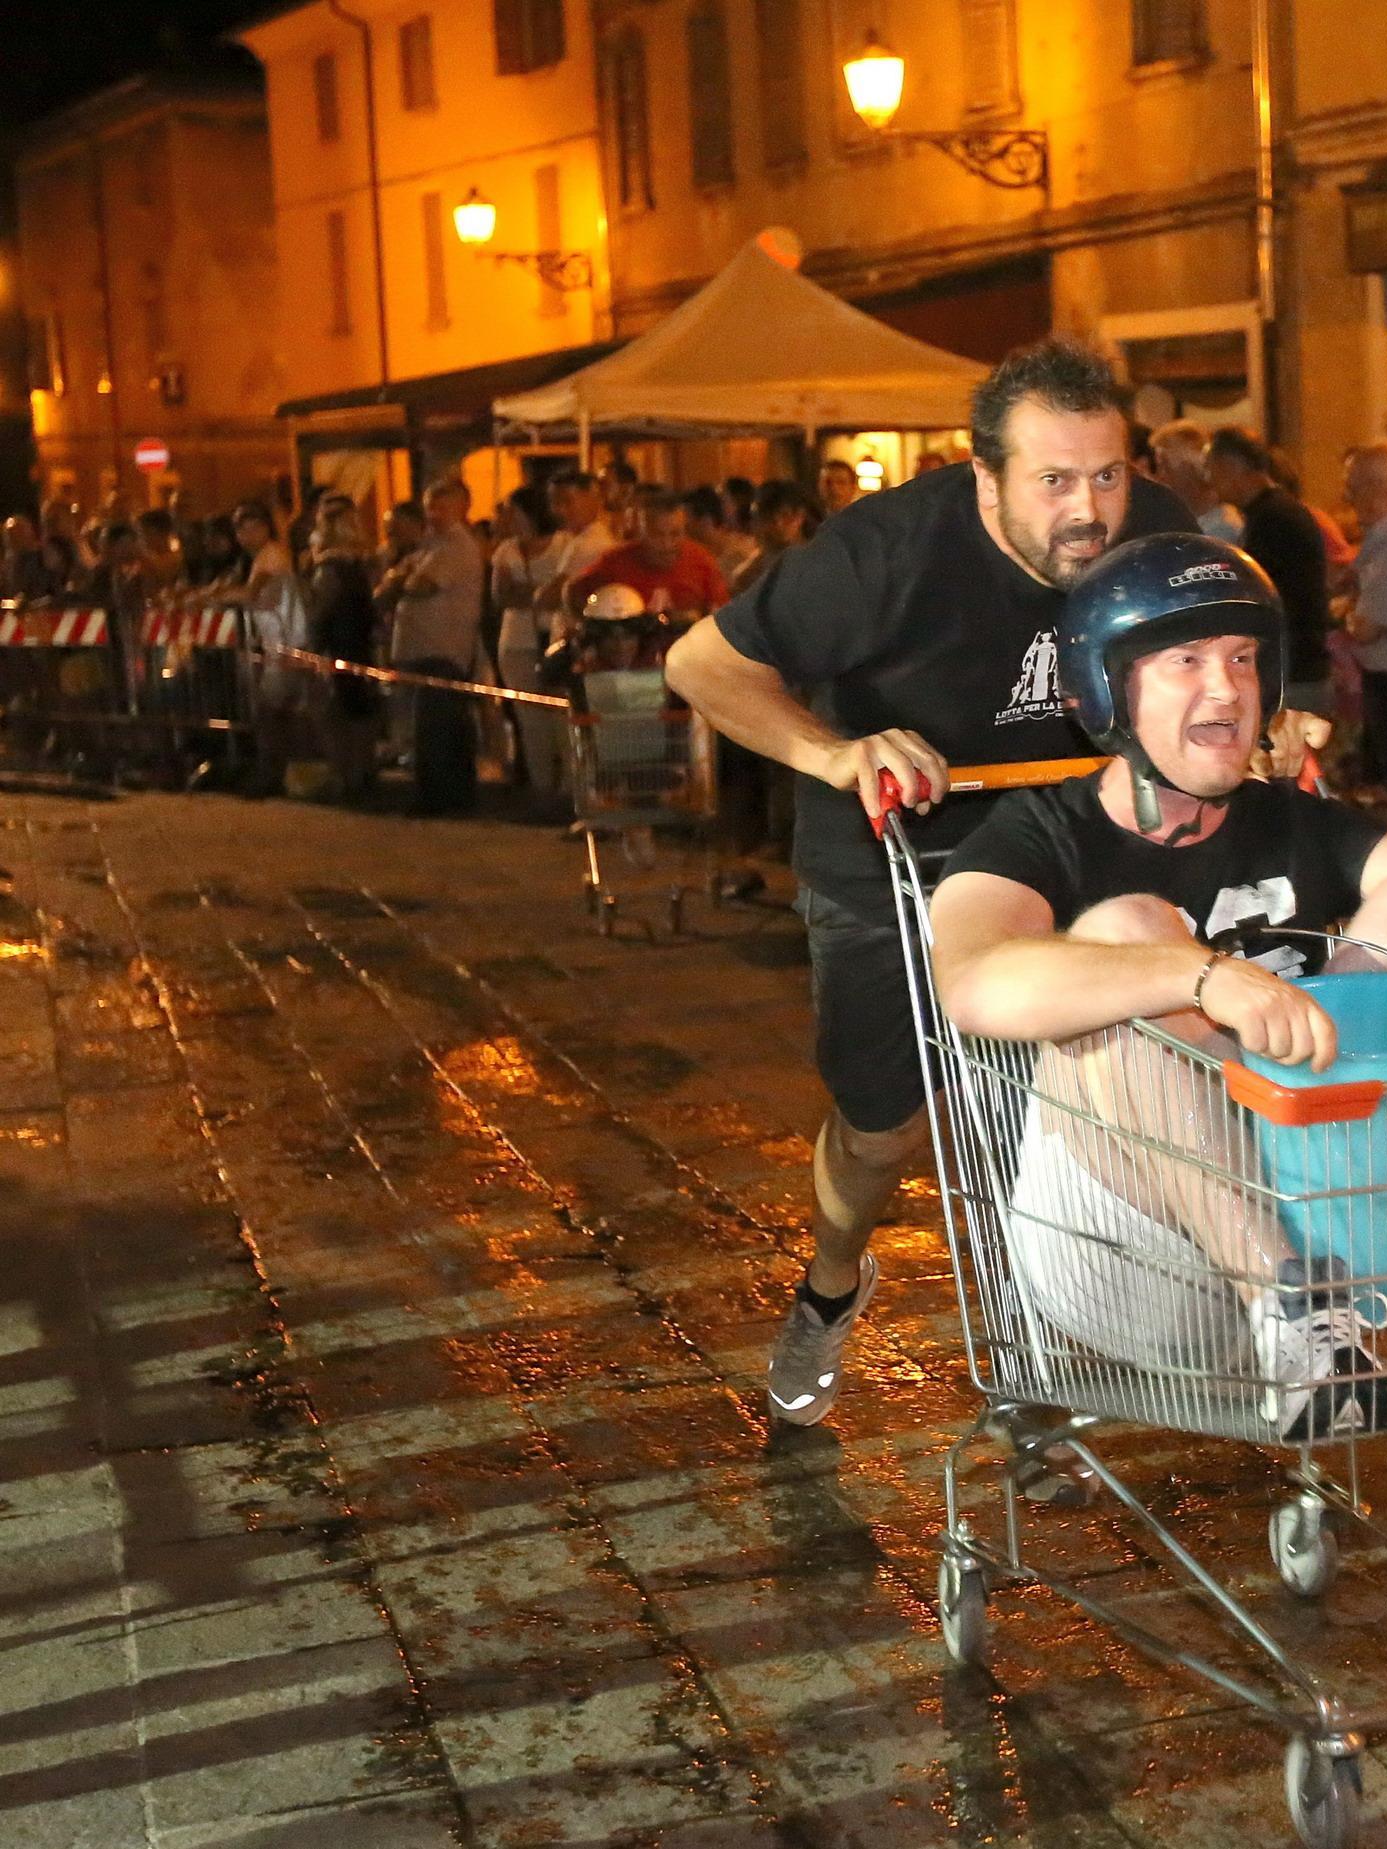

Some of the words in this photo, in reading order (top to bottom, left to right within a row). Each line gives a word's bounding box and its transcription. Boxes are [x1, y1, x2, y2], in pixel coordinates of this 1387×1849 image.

[1168, 570, 1238, 587] BIKE
[995, 706, 1022, 719] LOTTA
[1023, 703, 1041, 713] PER
[1042, 701, 1055, 710] LA
